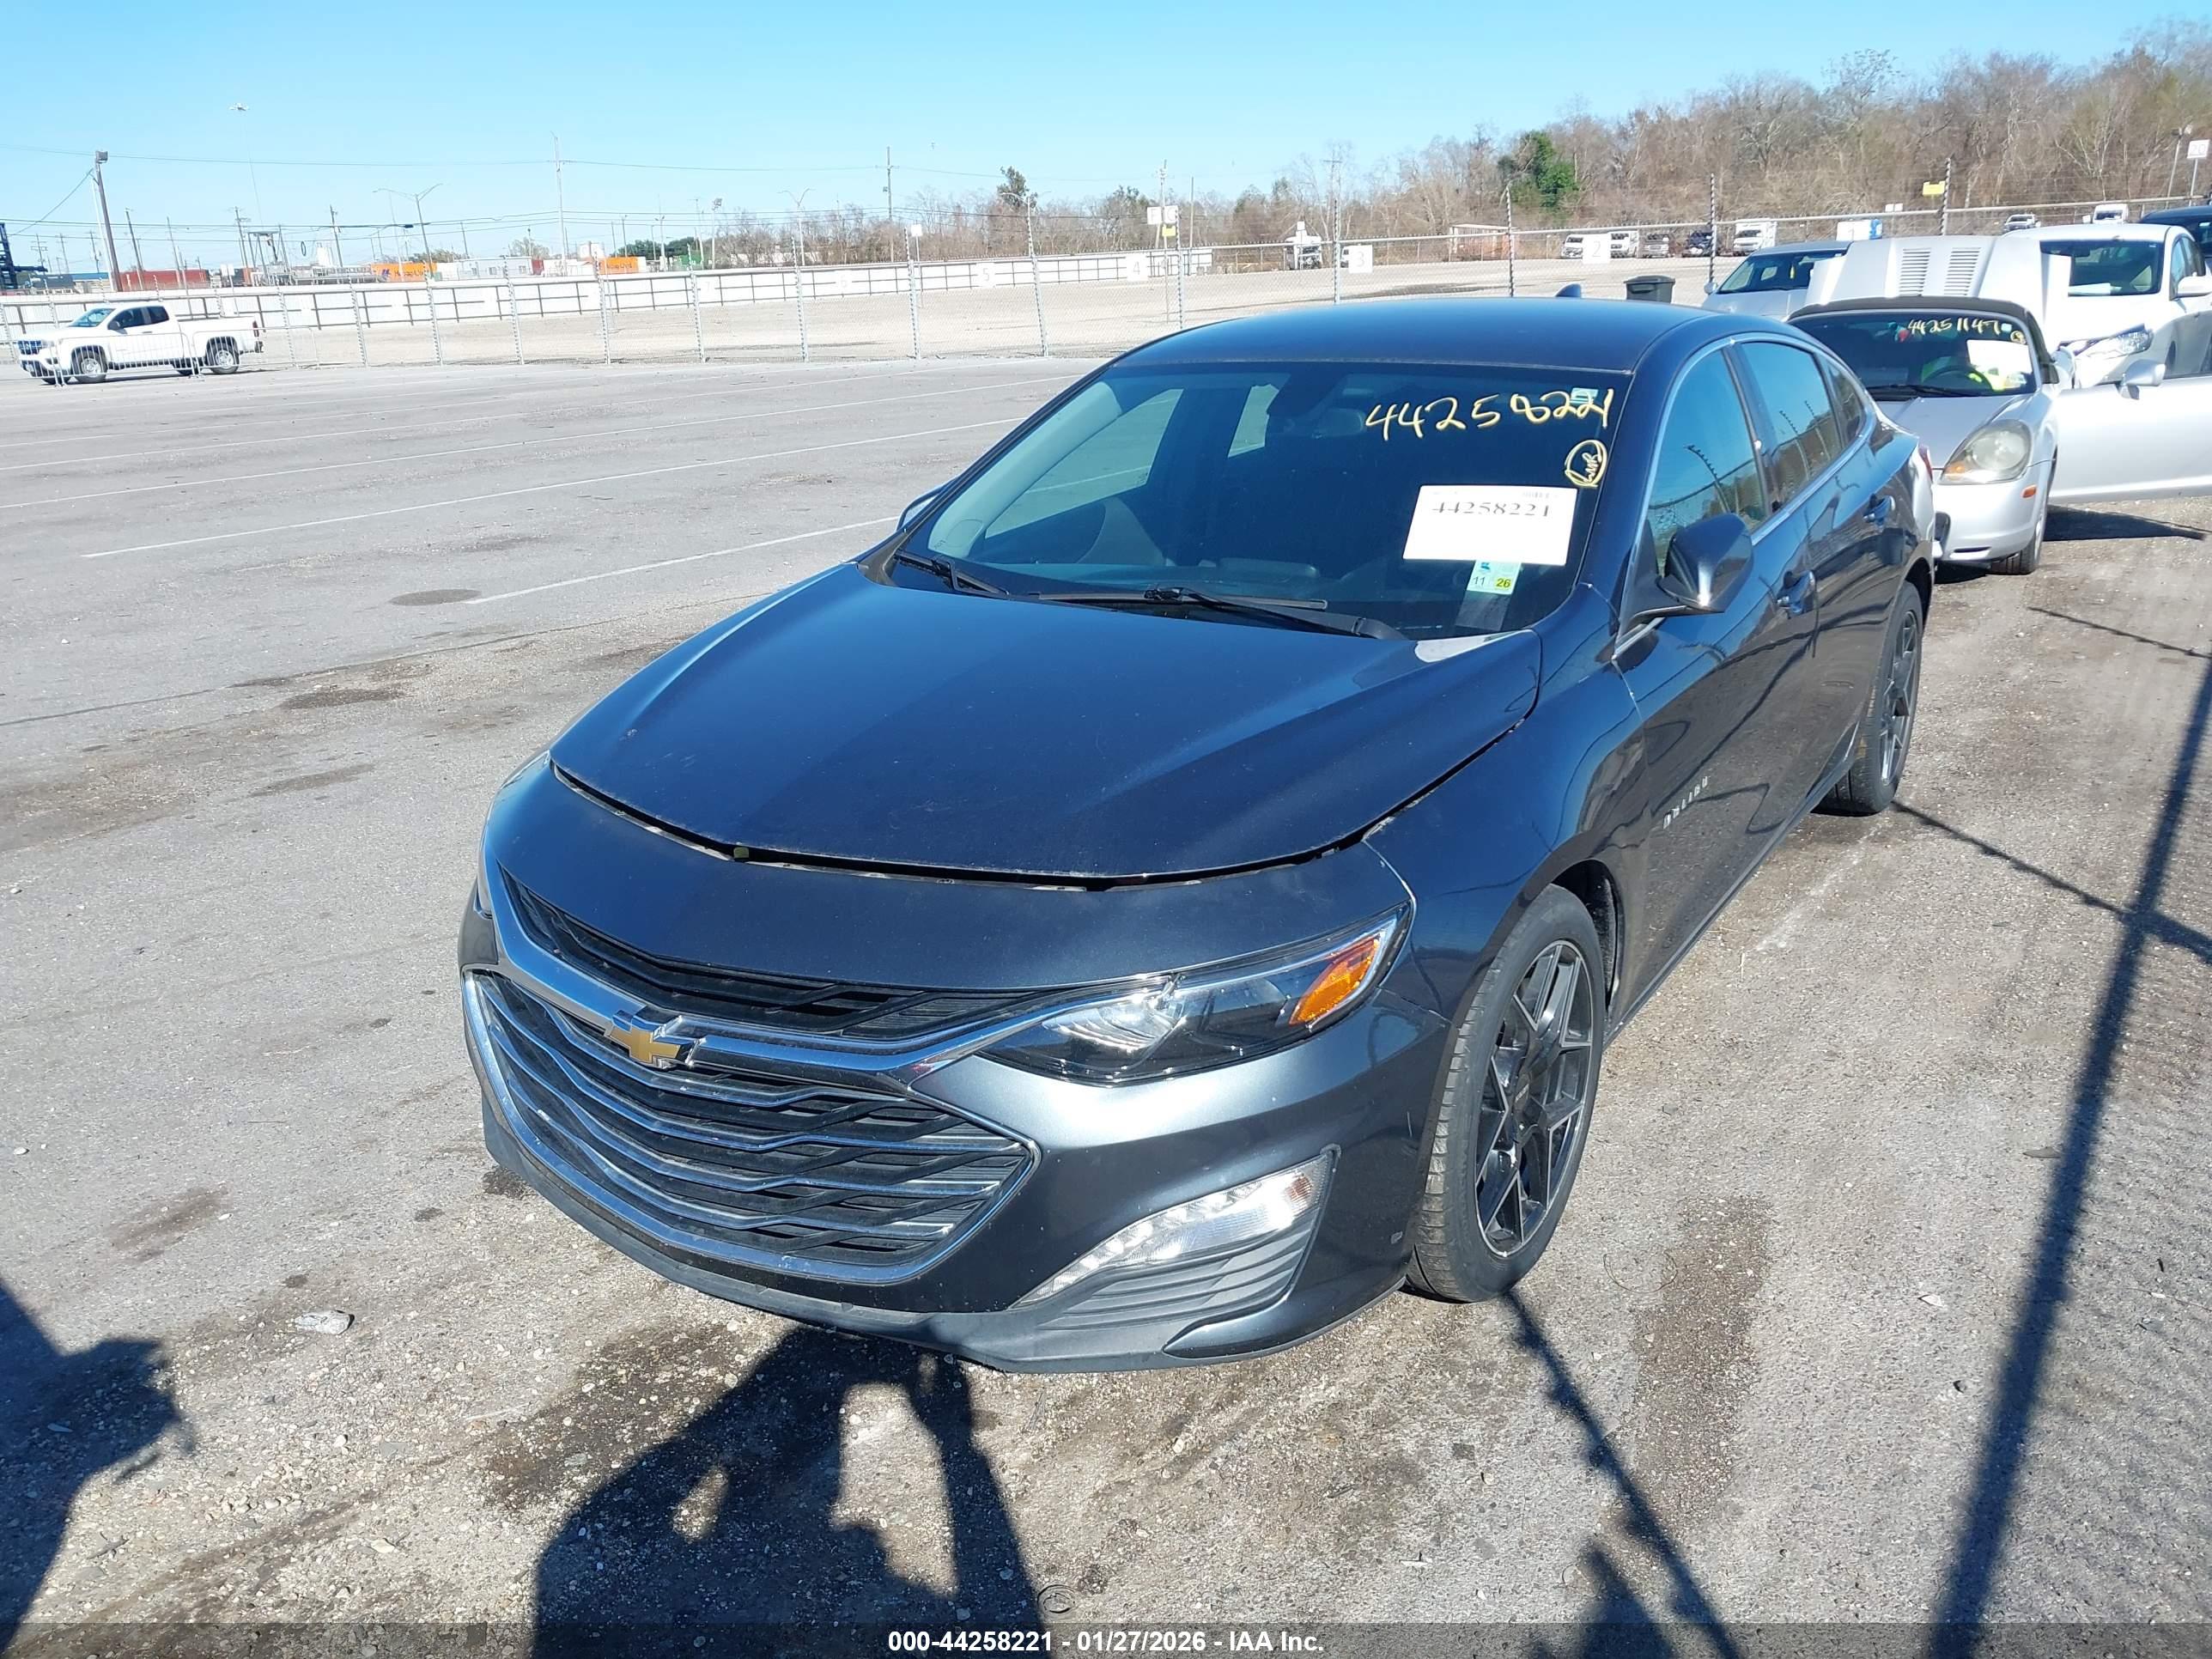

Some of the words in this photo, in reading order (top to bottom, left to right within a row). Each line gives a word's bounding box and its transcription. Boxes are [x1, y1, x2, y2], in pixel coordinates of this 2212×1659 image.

[1591, 240, 1601, 258] 2
[1356, 250, 1365, 268] 3
[982, 267, 990, 282] 5
[1133, 260, 1141, 276] 4
[1431, 501, 1550, 518] 44258221
[1495, 577, 1512, 588] 26
